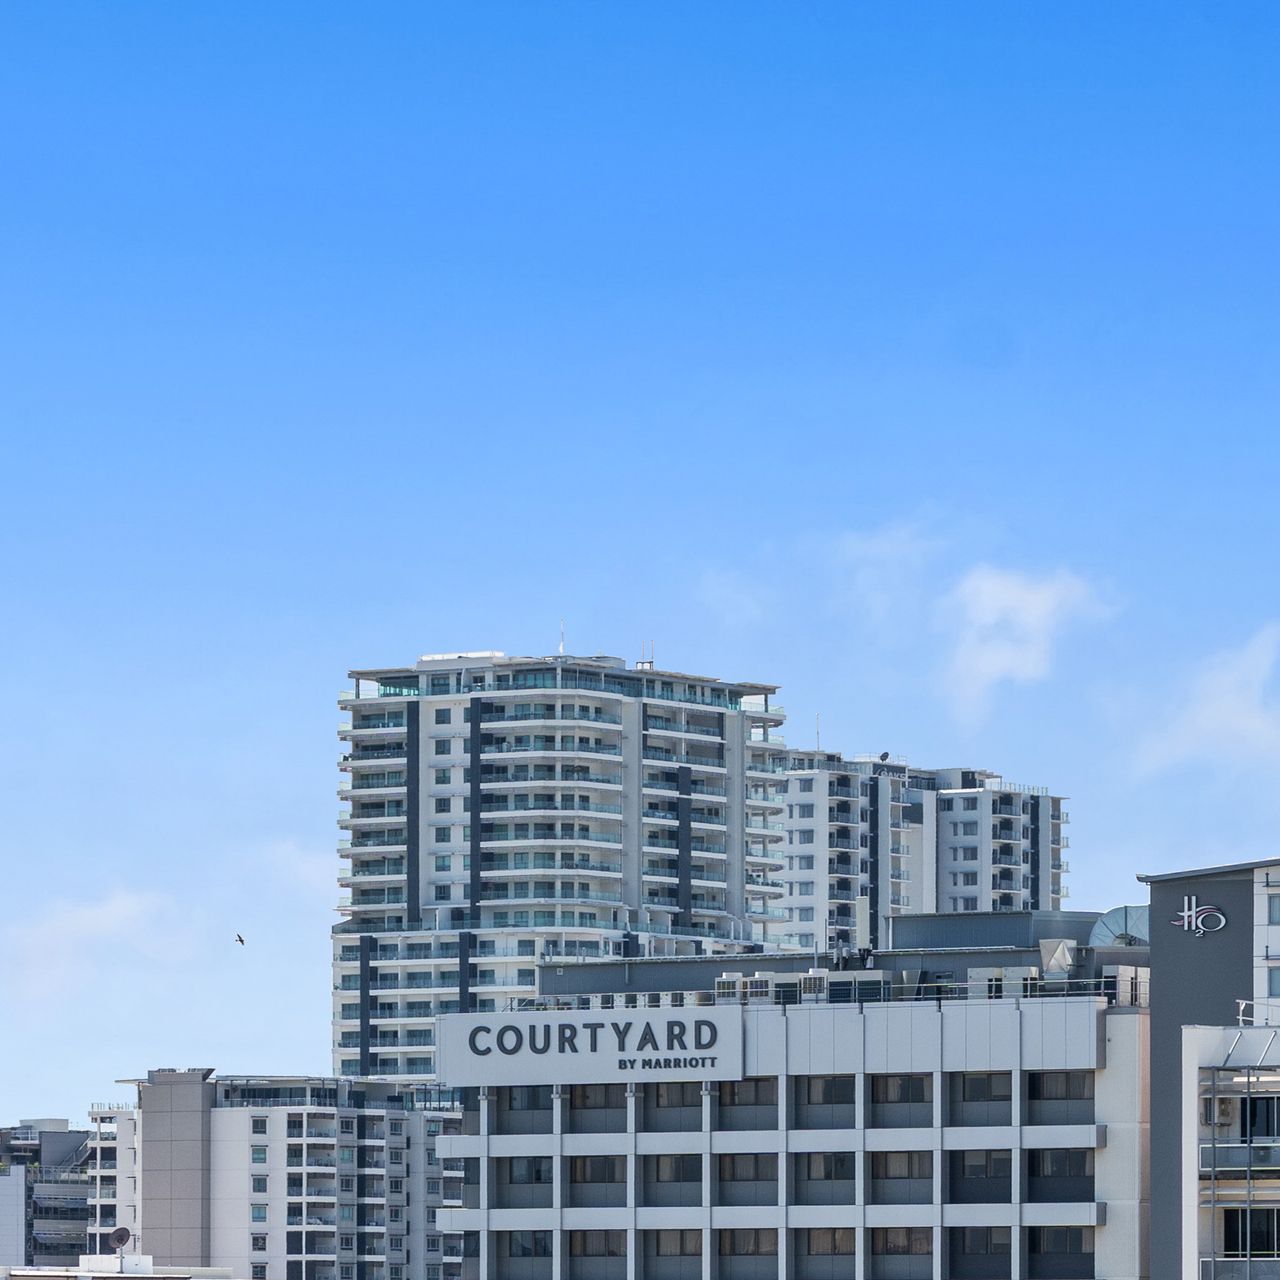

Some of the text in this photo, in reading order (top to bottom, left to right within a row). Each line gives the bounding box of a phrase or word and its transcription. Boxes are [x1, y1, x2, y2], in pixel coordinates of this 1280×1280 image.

[468, 1019, 718, 1057] COURTYARD
[618, 1056, 718, 1070] BY MARRIOTT
